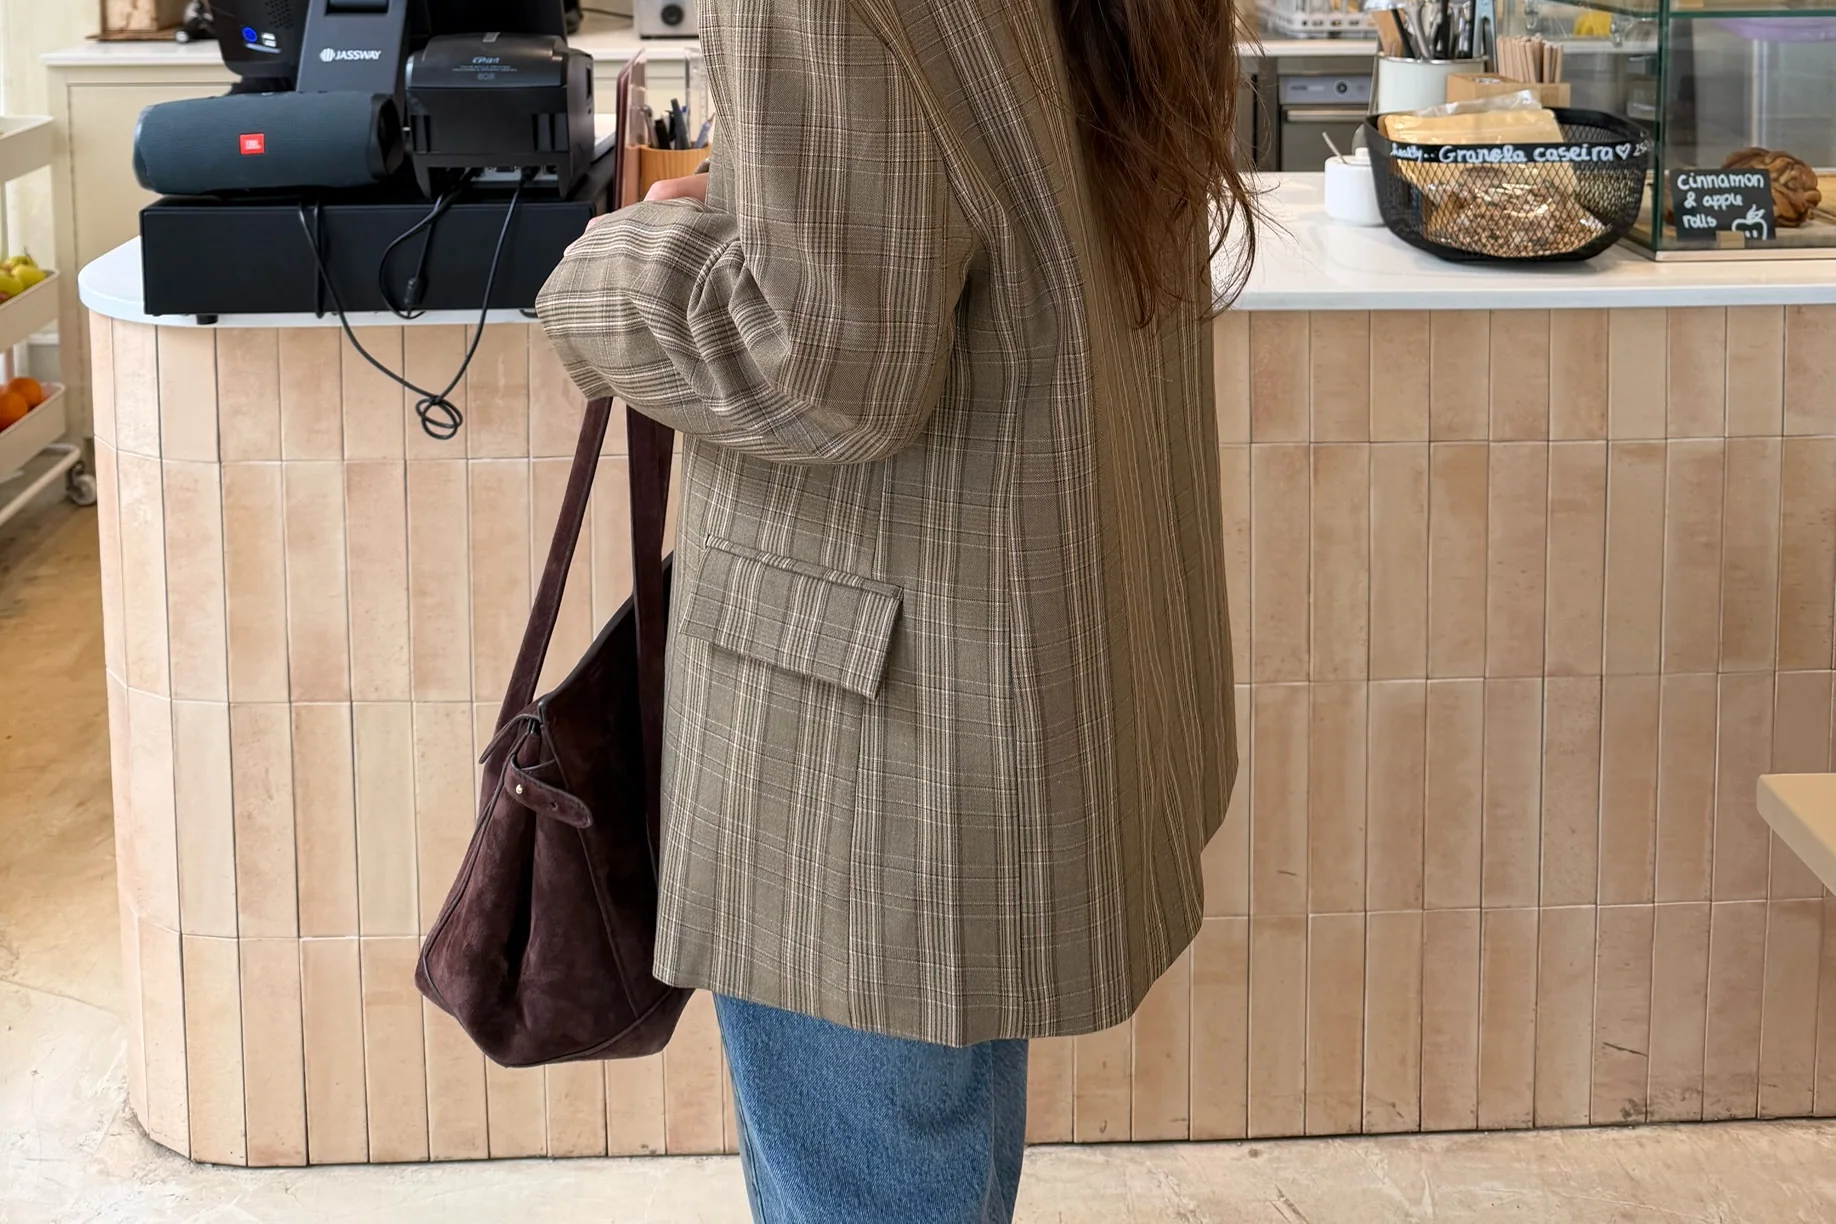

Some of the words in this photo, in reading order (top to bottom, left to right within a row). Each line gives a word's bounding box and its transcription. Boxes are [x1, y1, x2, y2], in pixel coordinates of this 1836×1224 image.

[335, 49, 382, 61] JASSWAY
[1439, 145, 1528, 163] Granola
[1533, 144, 1615, 162] caseira
[1684, 191, 1697, 208] &
[1702, 193, 1744, 210] apple
[1682, 214, 1717, 228] rolls
